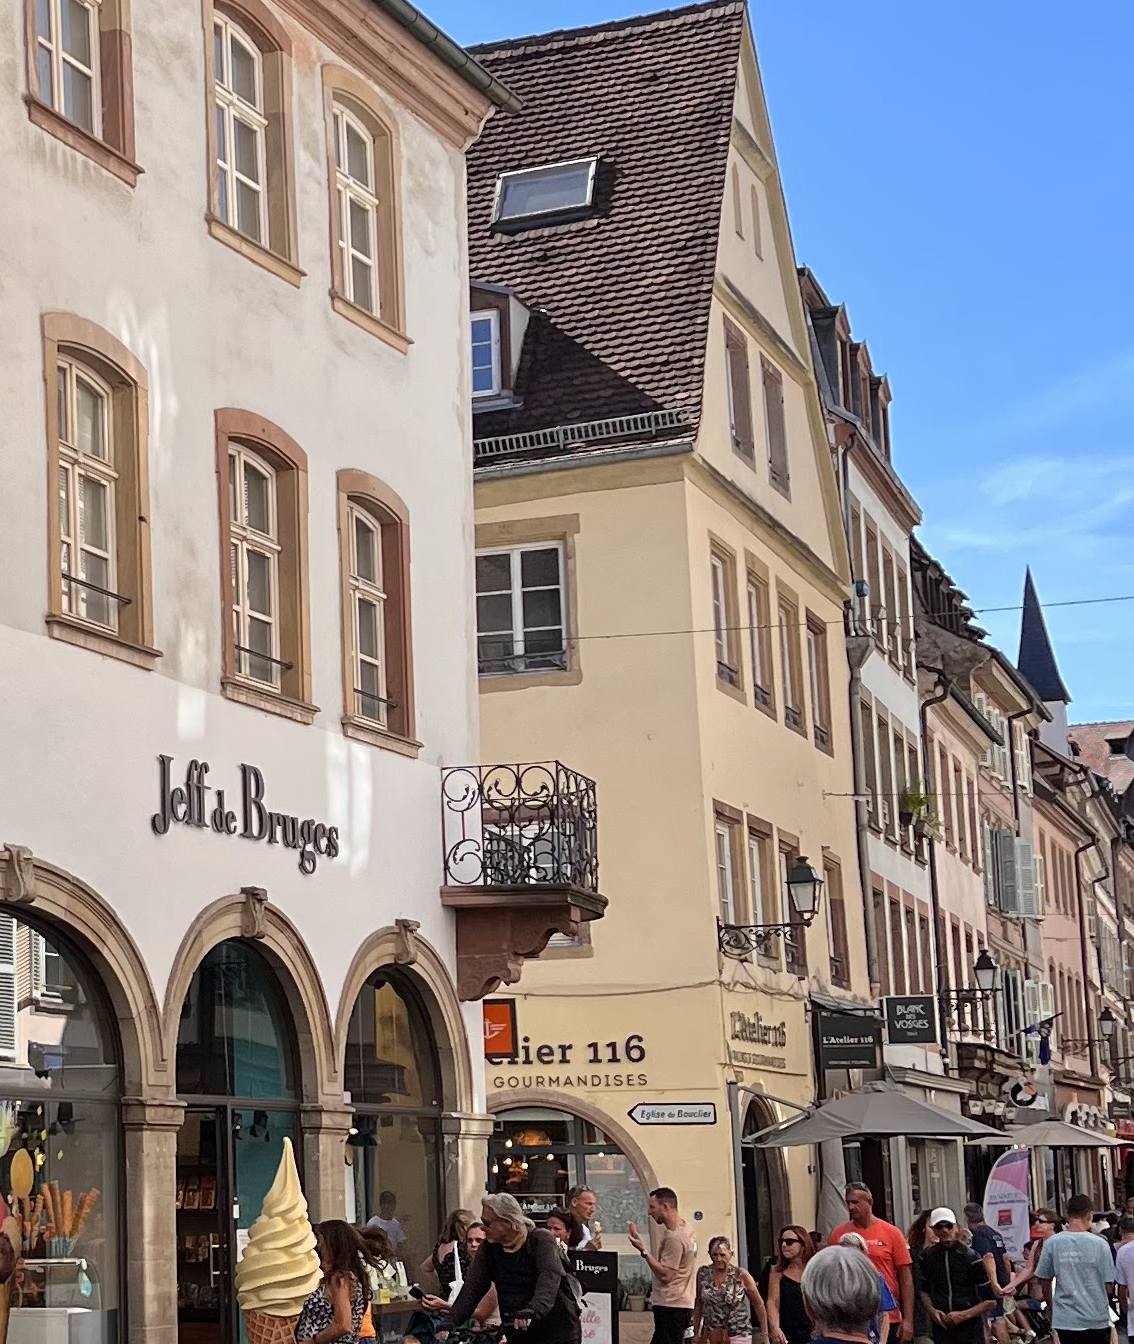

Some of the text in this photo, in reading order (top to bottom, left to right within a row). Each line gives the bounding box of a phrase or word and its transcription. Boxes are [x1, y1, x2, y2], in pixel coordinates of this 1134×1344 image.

[151, 754, 340, 874] Jeff de Bruges
[894, 1019, 929, 1029] VOSGES
[822, 1035, 859, 1044] L'Atelier
[587, 1034, 646, 1064] 116
[493, 1073, 649, 1089] GOURMANDISES
[575, 1259, 609, 1275] Bruges
